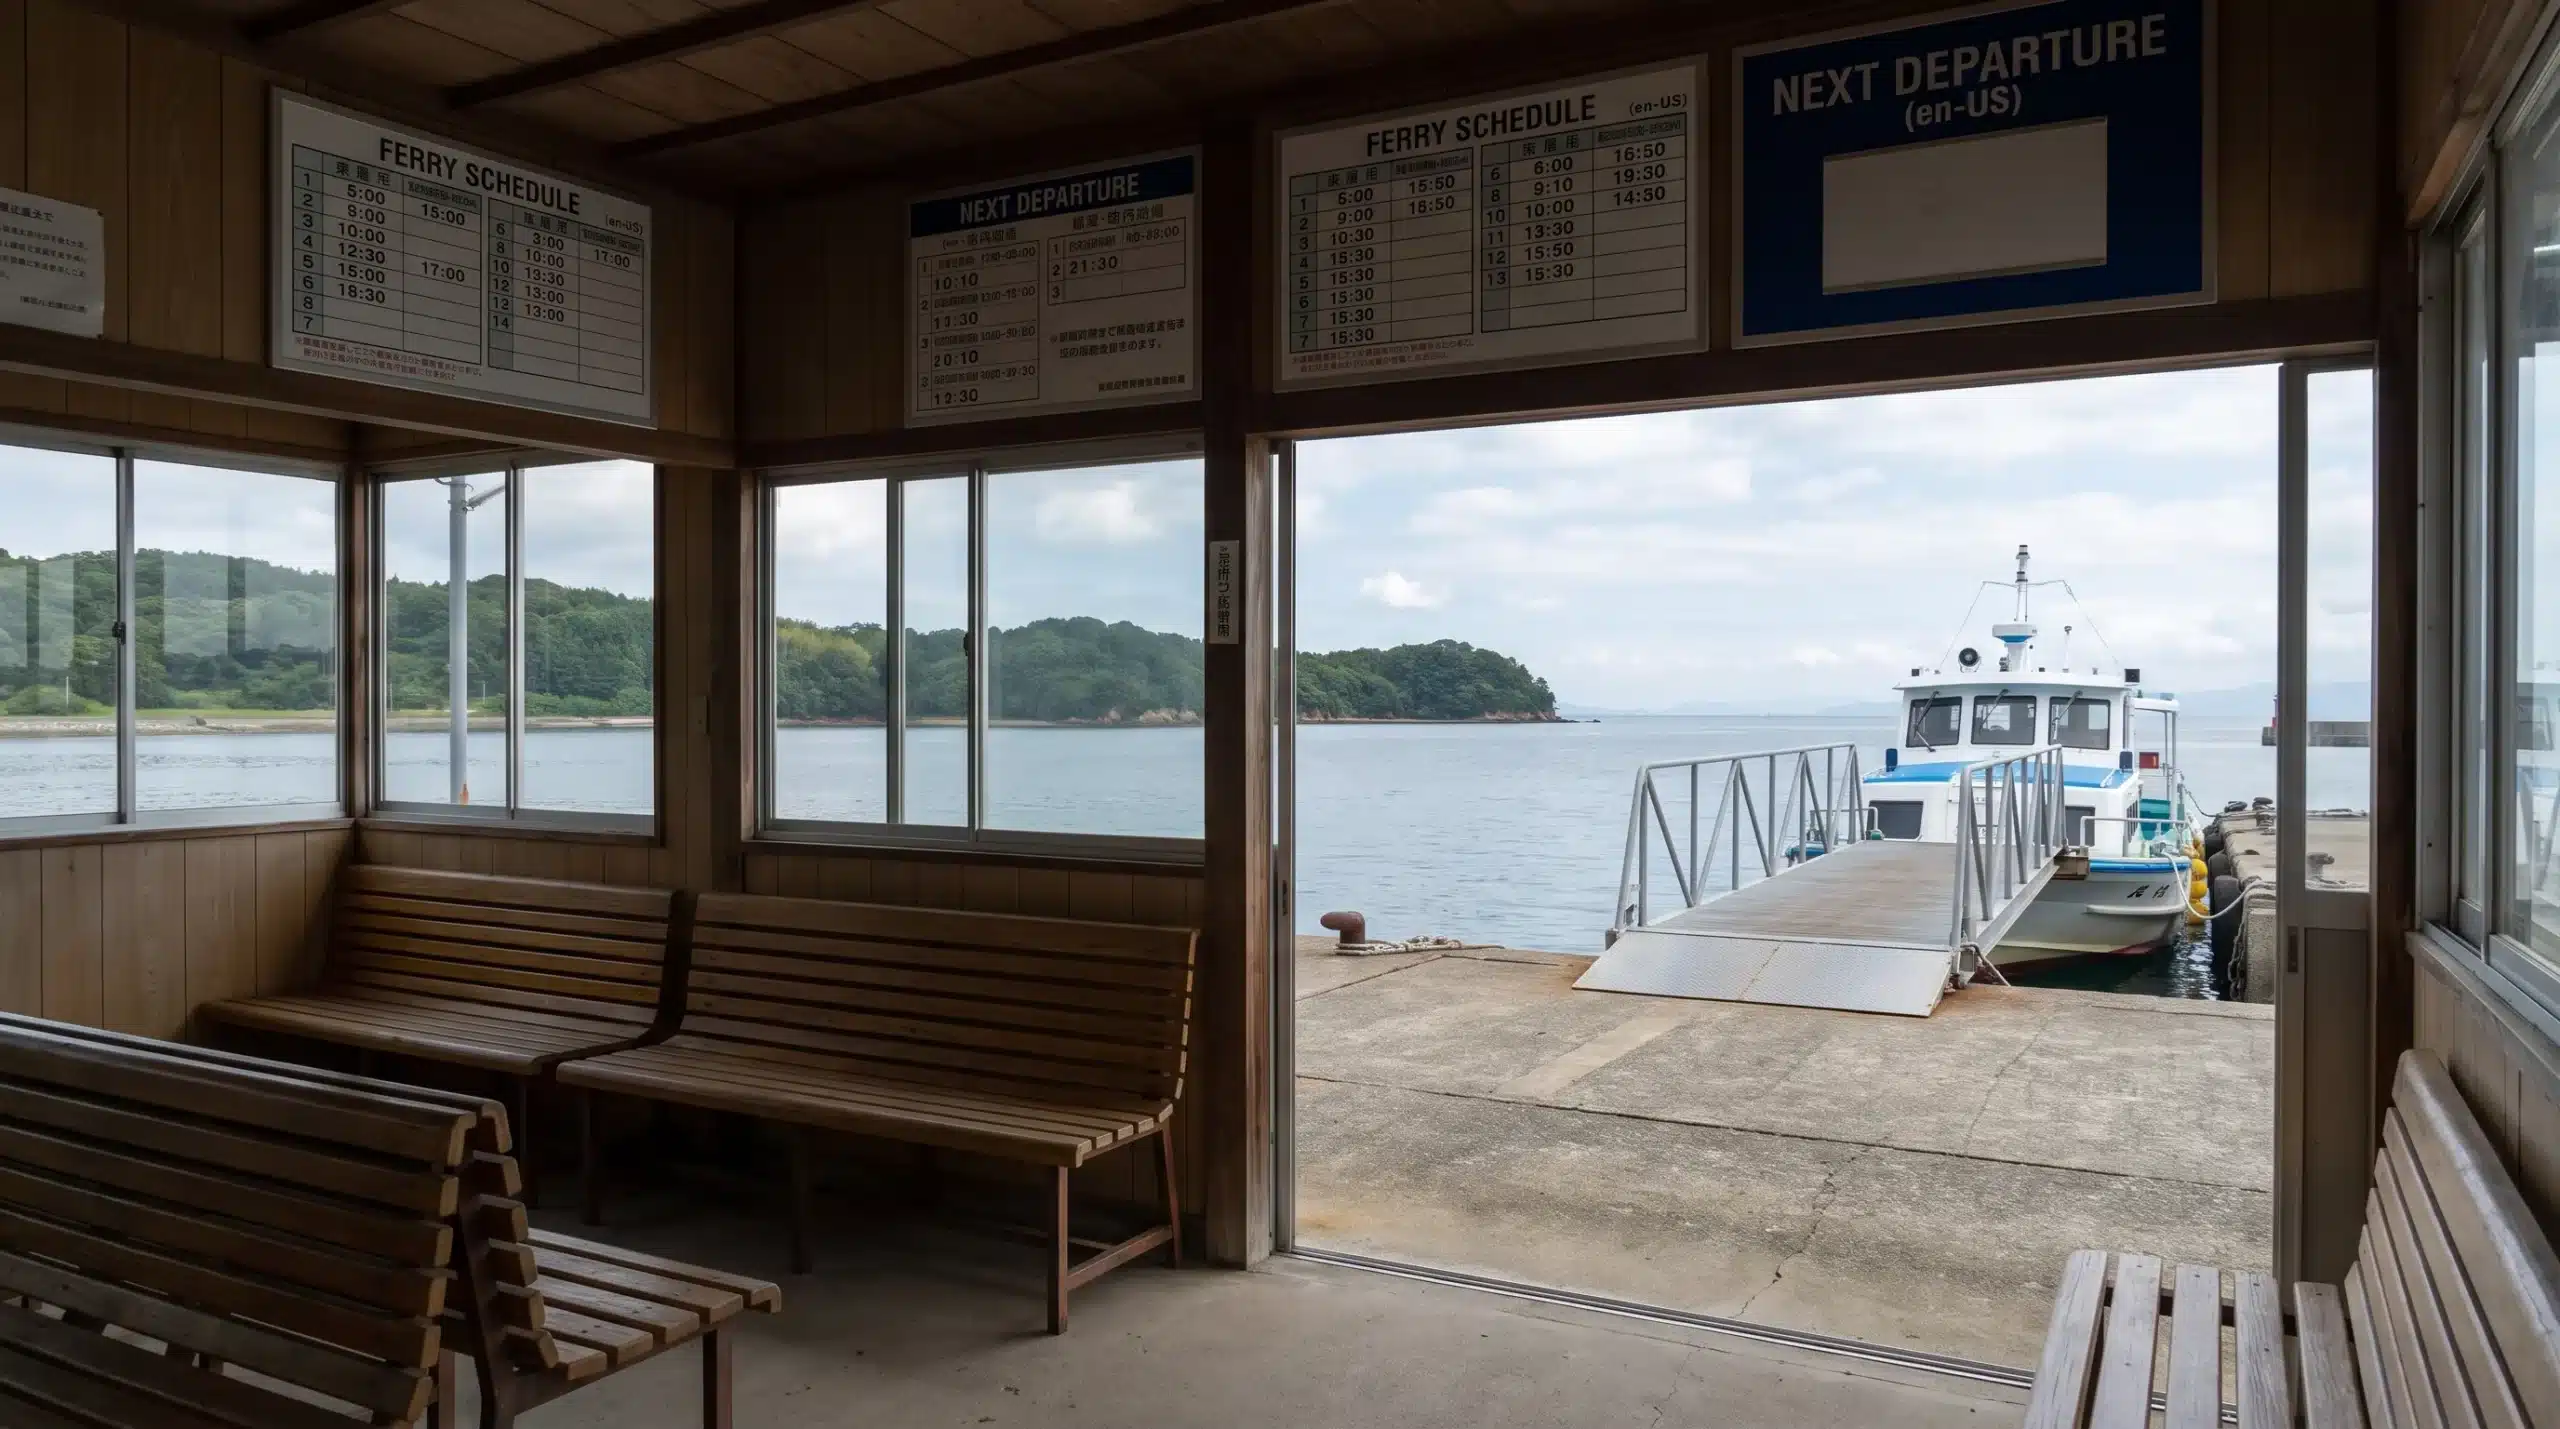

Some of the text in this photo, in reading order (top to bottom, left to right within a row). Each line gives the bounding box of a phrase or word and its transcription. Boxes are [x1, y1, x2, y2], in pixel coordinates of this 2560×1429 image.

[1772, 13, 2167, 116] NEXT DEPARTURE
[1629, 93, 1687, 116] (en-US)
[1905, 83, 2022, 132] (en-US)
[1367, 119, 1447, 157] FERRY
[1456, 94, 1597, 142] SCHEDULE
[1490, 142, 1666, 181] 6 6:00 16:50
[379, 137, 458, 181] FERRY
[465, 162, 580, 216] SCHEDULE
[1490, 164, 1666, 202] 8 9:10 19:30
[303, 194, 312, 207] 2
[304, 172, 312, 187] 1
[347, 184, 385, 204] 5:00
[422, 204, 466, 226] 15:00
[960, 172, 1140, 224] NEXT DEPARTURE
[1300, 198, 1307, 212] 1
[1409, 174, 1455, 194] 15:50
[1300, 218, 1308, 232] 2
[1337, 207, 1374, 226] 9:00
[1487, 210, 1505, 224] 10
[1524, 198, 1574, 218] 10:00
[304, 214, 385, 244] 3 10:00
[1300, 227, 1374, 250] 3 10:30
[1487, 220, 1574, 244] 11 13:30
[496, 222, 505, 236] 6
[594, 248, 630, 268] 17:00
[496, 242, 564, 268] 8 10:00
[1487, 242, 1574, 266] 12 15:50
[302, 235, 466, 282] 4 12:30 17:00
[303, 256, 385, 284] 5 15:00
[1052, 256, 1118, 276] 2 21:30
[1299, 247, 1374, 270] 4 15:30
[493, 259, 564, 286] 10 13:30
[935, 272, 978, 290] 10:10
[1300, 267, 1374, 290] 5 15:30
[1487, 263, 1574, 286] 13 15:30
[303, 276, 386, 304] 6 18:30
[493, 277, 564, 304] 12 13:00
[1052, 286, 1060, 298] 3
[1300, 287, 1374, 309] 6 15:30
[303, 296, 313, 310] 8
[525, 302, 564, 322] 13:00
[920, 300, 928, 310] 2
[304, 317, 313, 330] 7
[493, 314, 510, 330] 14
[1300, 307, 1374, 329] 7 15:30
[1300, 327, 1374, 348] 7 15:30
[934, 350, 978, 368] 20:10
